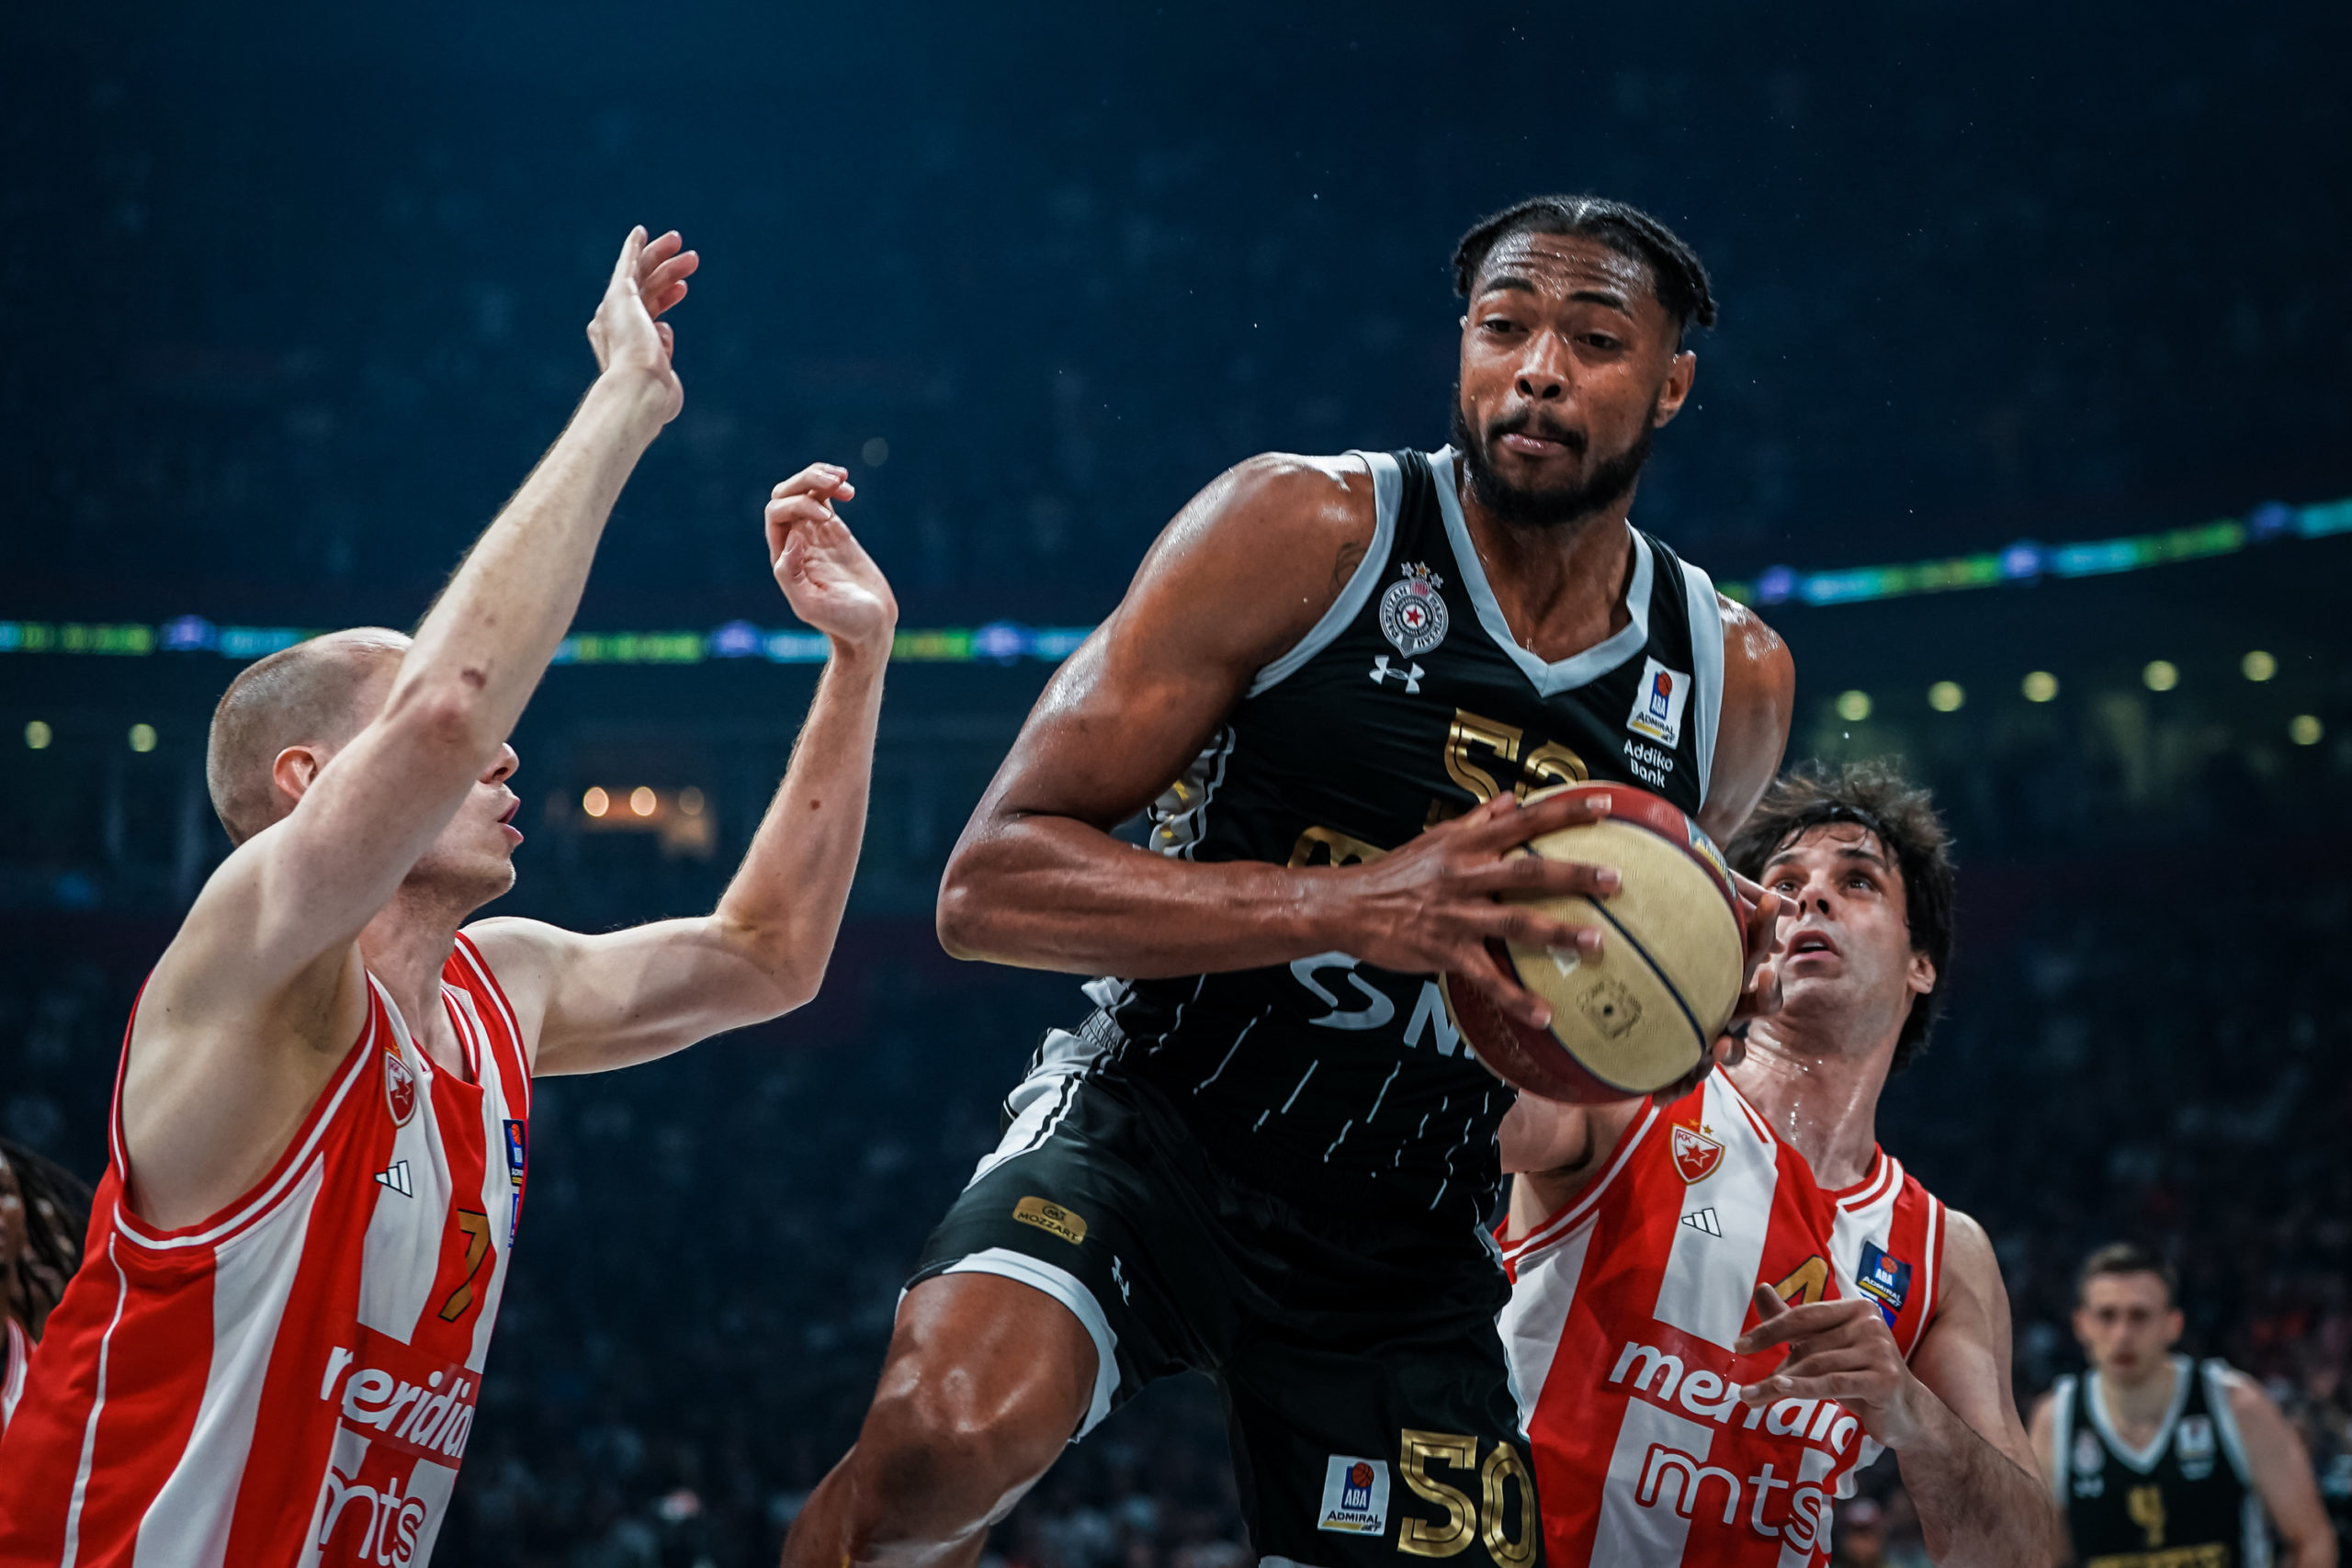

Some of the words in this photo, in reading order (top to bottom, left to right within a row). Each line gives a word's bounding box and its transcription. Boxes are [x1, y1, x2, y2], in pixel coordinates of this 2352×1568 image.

[1651, 693, 1666, 716] ABA
[1635, 711, 1675, 734] ADMIRAL
[1623, 739, 1674, 773] Addiko
[1630, 757, 1666, 788] Bank
[1017, 1213, 1079, 1240] MOZZART
[1861, 1276, 1903, 1303] ADMIRAL
[1875, 1268, 1894, 1287] ABA
[1344, 1489, 1367, 1508] ABA
[1397, 1428, 1536, 1568] 50
[1641, 1448, 1823, 1551] mts
[1328, 1510, 1379, 1525] ADMIRAL
